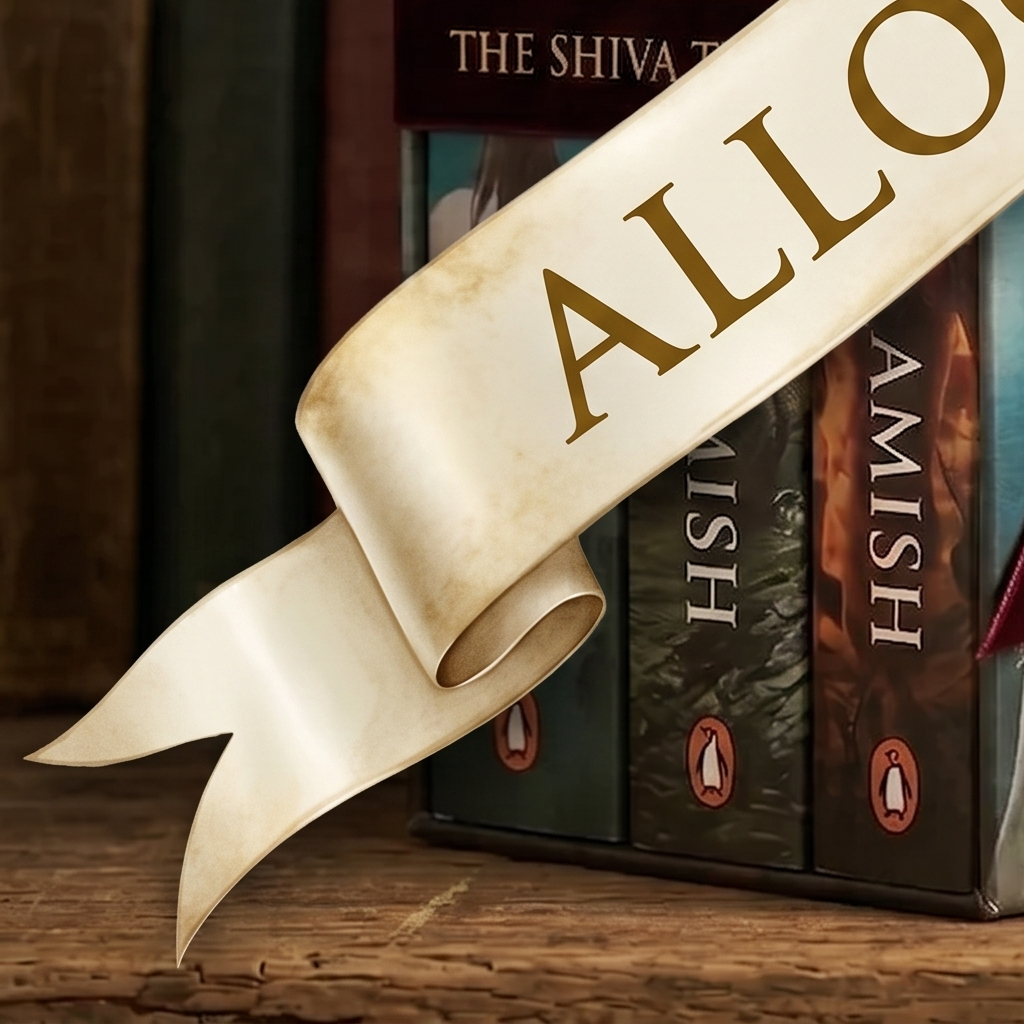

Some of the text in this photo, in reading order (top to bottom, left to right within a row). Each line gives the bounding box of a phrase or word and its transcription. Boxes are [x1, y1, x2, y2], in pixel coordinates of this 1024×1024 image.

[449, 29, 677, 83] THE SHIVA
[868, 328, 923, 650] AMISH
